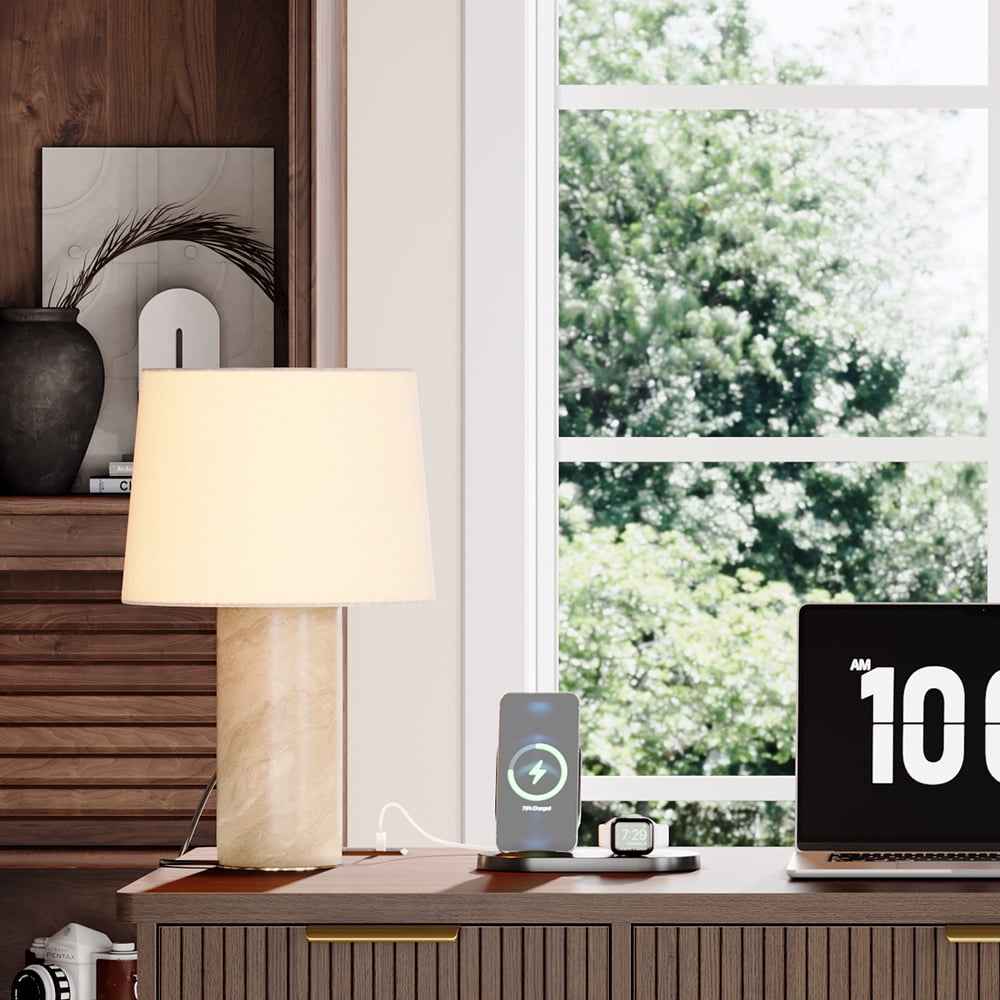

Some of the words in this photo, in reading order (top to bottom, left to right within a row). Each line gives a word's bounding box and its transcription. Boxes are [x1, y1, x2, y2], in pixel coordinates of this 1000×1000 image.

[849, 658, 872, 671] AM
[860, 666, 966, 785] 10
[621, 828, 648, 841] 7:29
[46, 951, 76, 961] PENTAX
